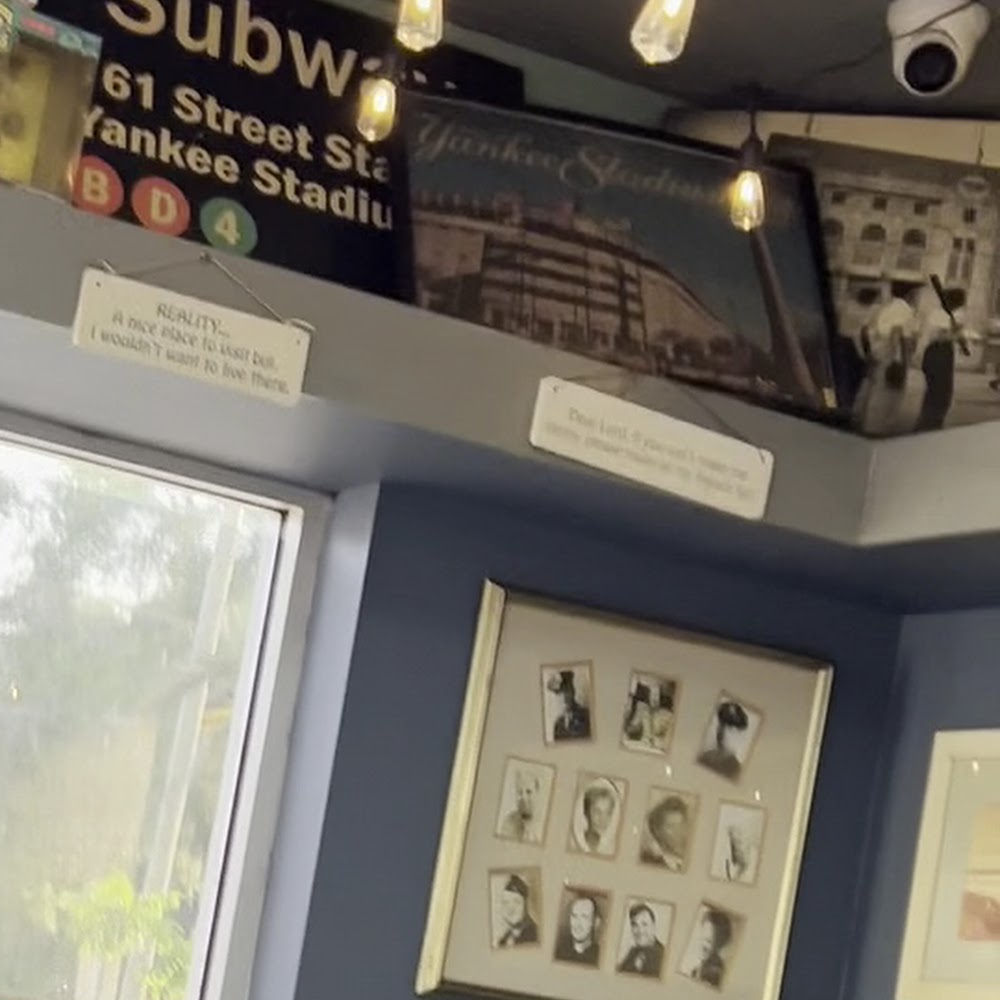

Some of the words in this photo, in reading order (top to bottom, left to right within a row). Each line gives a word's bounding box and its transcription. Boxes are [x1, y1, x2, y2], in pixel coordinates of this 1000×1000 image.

[105, 0, 384, 97] Subw
[82, 104, 241, 184] Yankee
[251, 157, 393, 231] Stadiu
[172, 84, 314, 161] Street
[323, 133, 392, 183] Sta
[81, 169, 109, 198] B
[150, 189, 178, 223] D
[214, 210, 241, 245] 4
